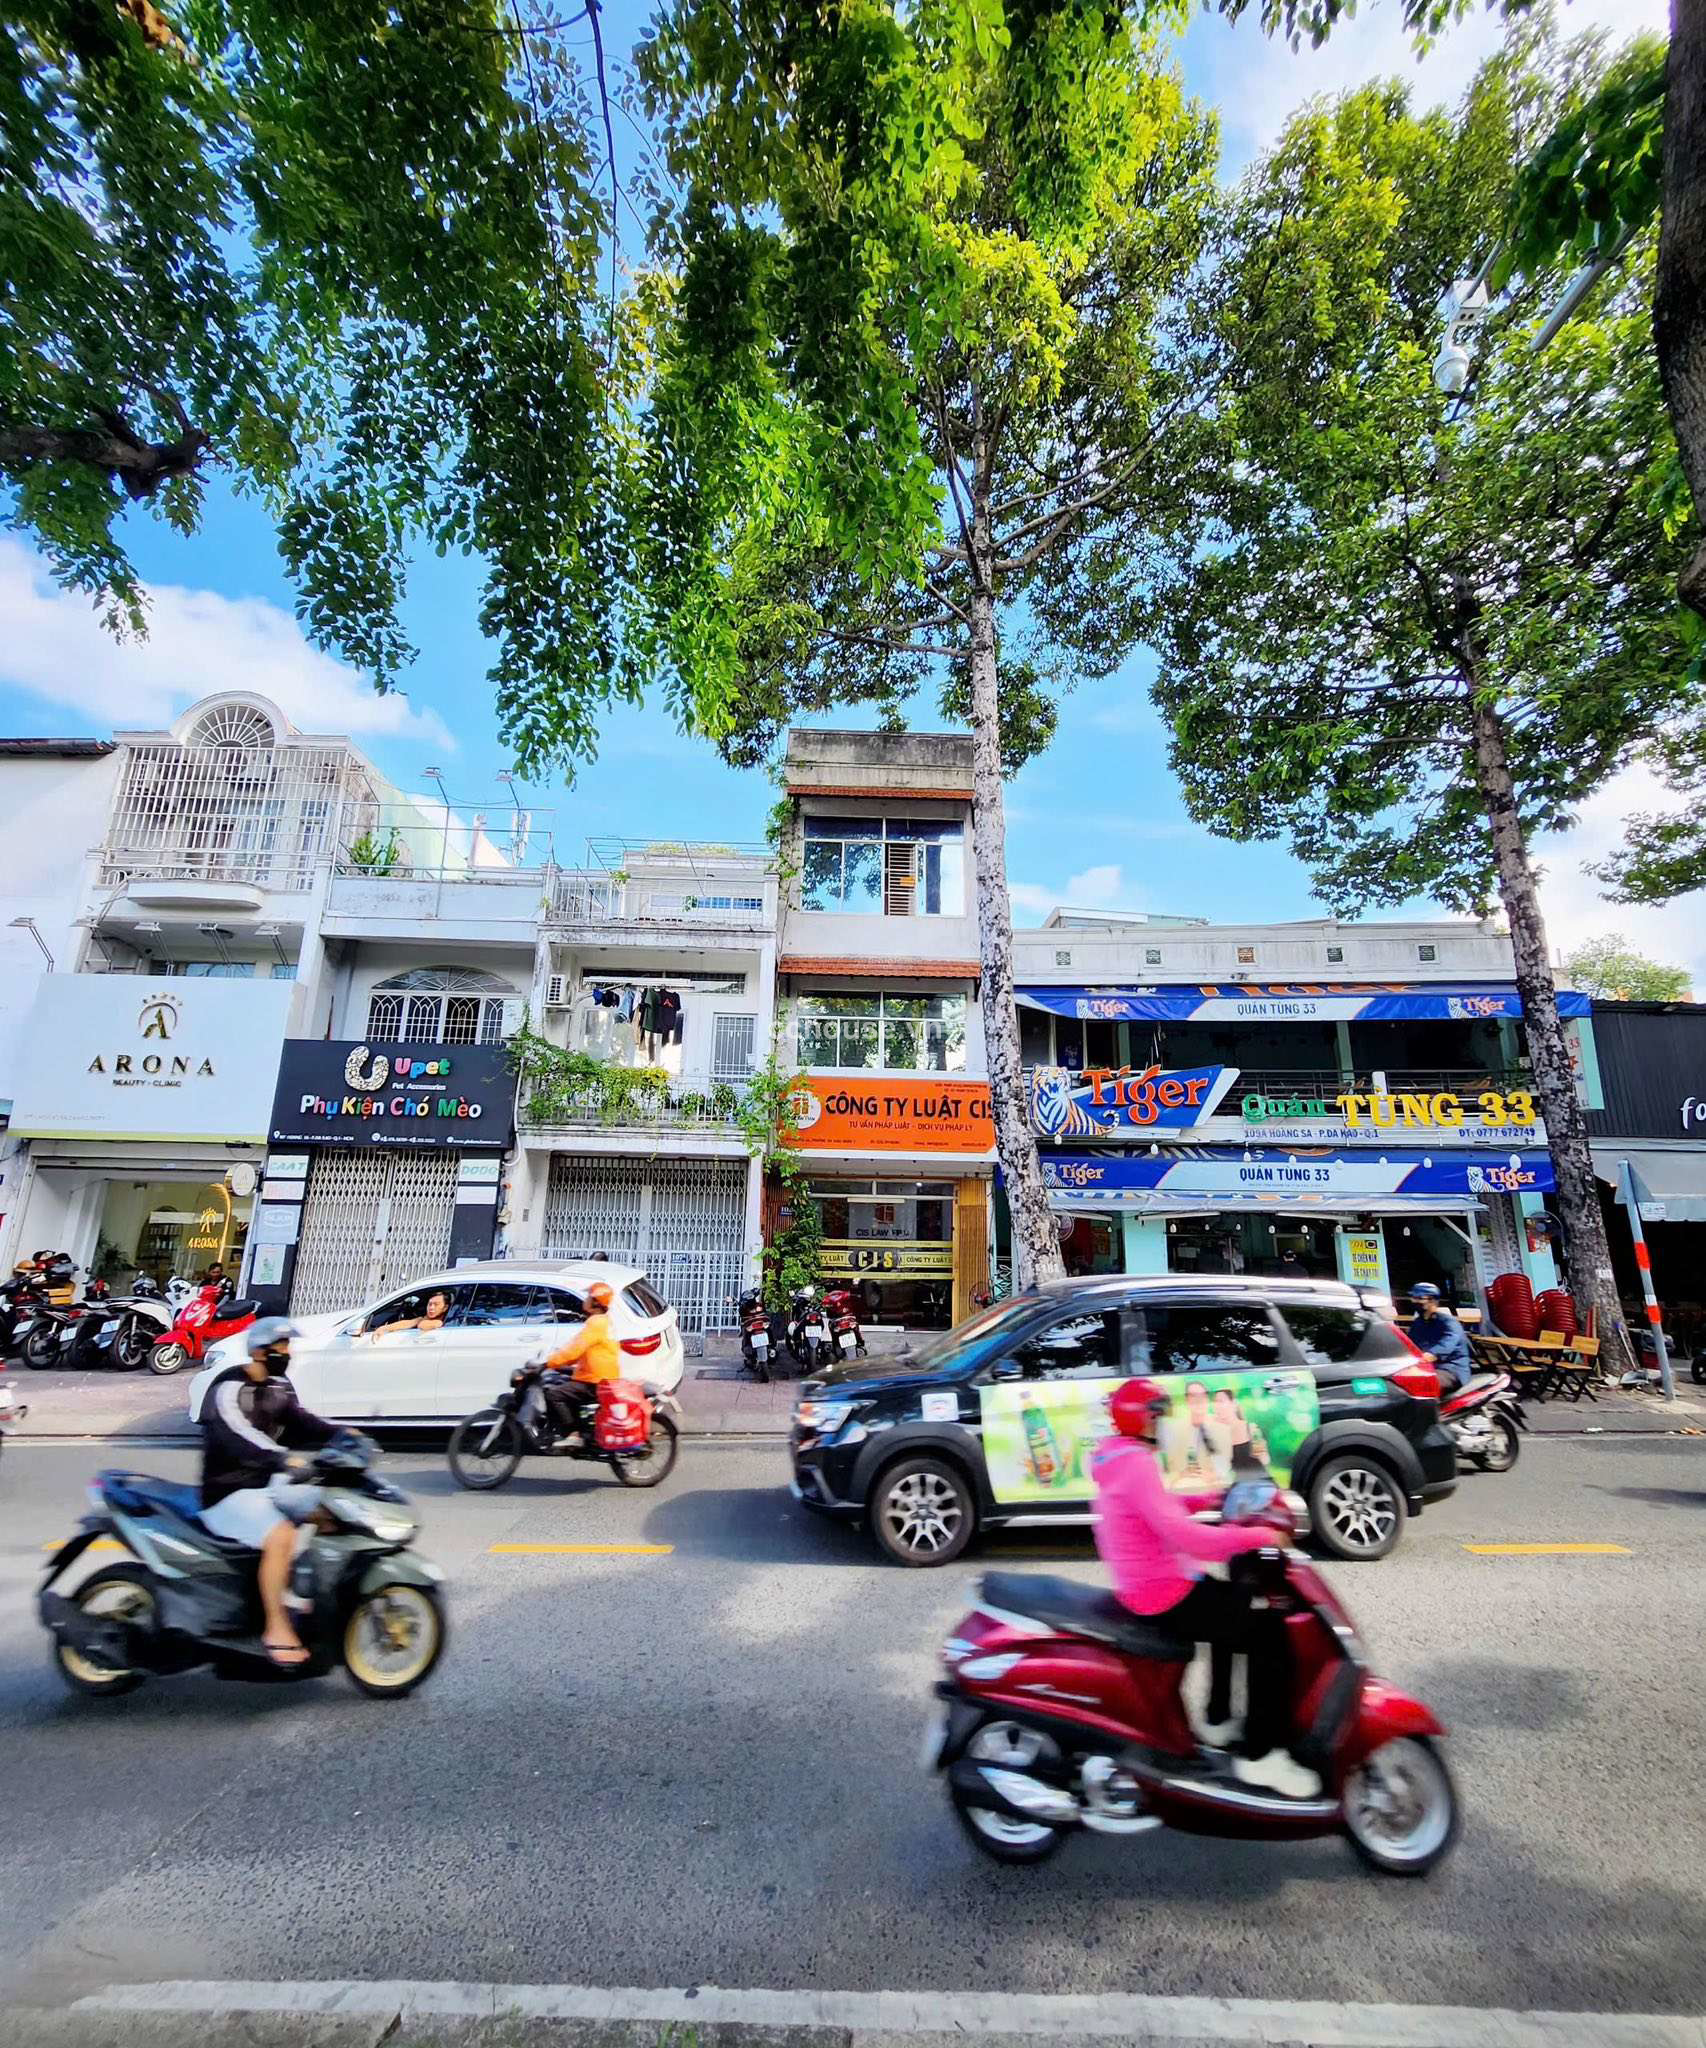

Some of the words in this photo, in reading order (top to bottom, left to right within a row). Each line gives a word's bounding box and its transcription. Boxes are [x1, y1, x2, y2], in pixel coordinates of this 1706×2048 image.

[1089, 999, 1130, 1018] Tiger
[1237, 1001, 1267, 1016] QUÁN
[1270, 1001, 1300, 1015] TÙNG
[1303, 1003, 1317, 1015] 33
[1463, 996, 1505, 1016] Tiger
[87, 1053, 216, 1077] ARONA
[394, 1057, 450, 1079] Upet
[112, 1079, 146, 1087] BEAUTY
[152, 1080, 182, 1088] CLINIC
[1081, 1064, 1210, 1125] Tiger
[300, 1094, 340, 1120] Phụ
[341, 1095, 385, 1120] Kiện
[390, 1095, 430, 1118] Chó
[437, 1096, 482, 1119] Mèo
[825, 1091, 878, 1116] CÔNG
[884, 1097, 909, 1117] TY
[913, 1094, 962, 1120] LUẬT
[1241, 1092, 1328, 1125] Quán
[1336, 1087, 1466, 1129] TÙNG
[1477, 1091, 1537, 1127] 33
[1301, 1128, 1313, 1138] SA
[1364, 1129, 1380, 1139] Q.1
[1476, 1128, 1499, 1137] 0777
[1060, 1161, 1105, 1187] Tiger
[1239, 1165, 1273, 1182] QUÁN
[1276, 1165, 1311, 1181] TÙNG
[1314, 1168, 1330, 1181] 33
[1485, 1165, 1536, 1192] Tiger
[855, 1228, 870, 1237] CIS
[871, 1228, 889, 1237] LAW
[858, 1250, 893, 1269] CIS
